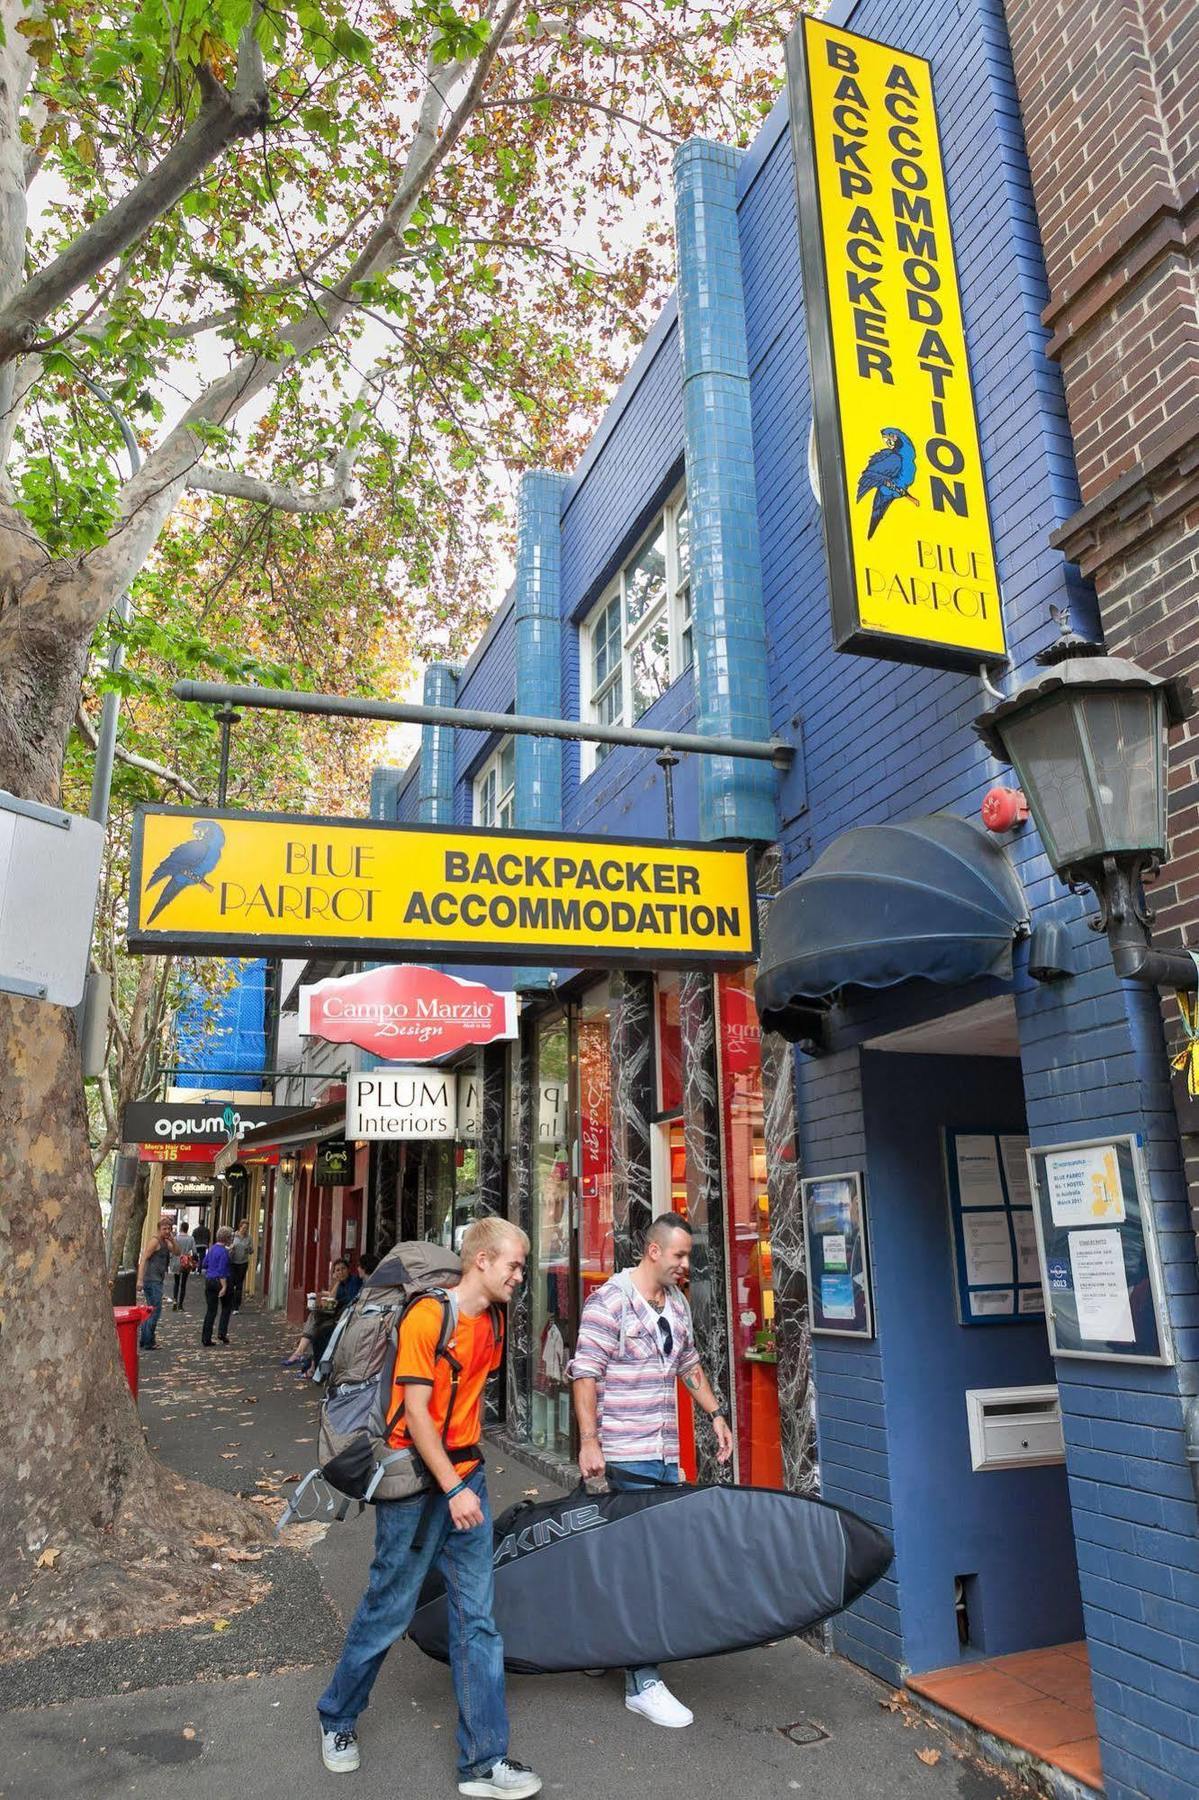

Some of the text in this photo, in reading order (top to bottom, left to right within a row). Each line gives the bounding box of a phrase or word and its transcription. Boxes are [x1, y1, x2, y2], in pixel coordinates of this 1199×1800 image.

[825, 39, 895, 386] BACKPACKER
[884, 64, 969, 518] ACCOMMODATION
[917, 540, 991, 582] BLUE
[865, 567, 991, 620] PARROT
[286, 841, 375, 879] BLUE
[444, 850, 701, 895] BACKPACKER
[220, 882, 381, 922] PARROT
[403, 891, 740, 937] ACCOMMODATION
[322, 998, 491, 1023] Campo Marzio
[374, 1021, 443, 1042] Design
[357, 1080, 448, 1108] PLUM
[154, 1116, 224, 1140] opium
[358, 1112, 448, 1133] Interiors
[583, 1079, 604, 1161] Design
[144, 1143, 164, 1151] Men's
[184, 1183, 215, 1192] alkaline
[1053, 1279, 1067, 1288] 2013
[493, 1503, 608, 1565] AKINE
